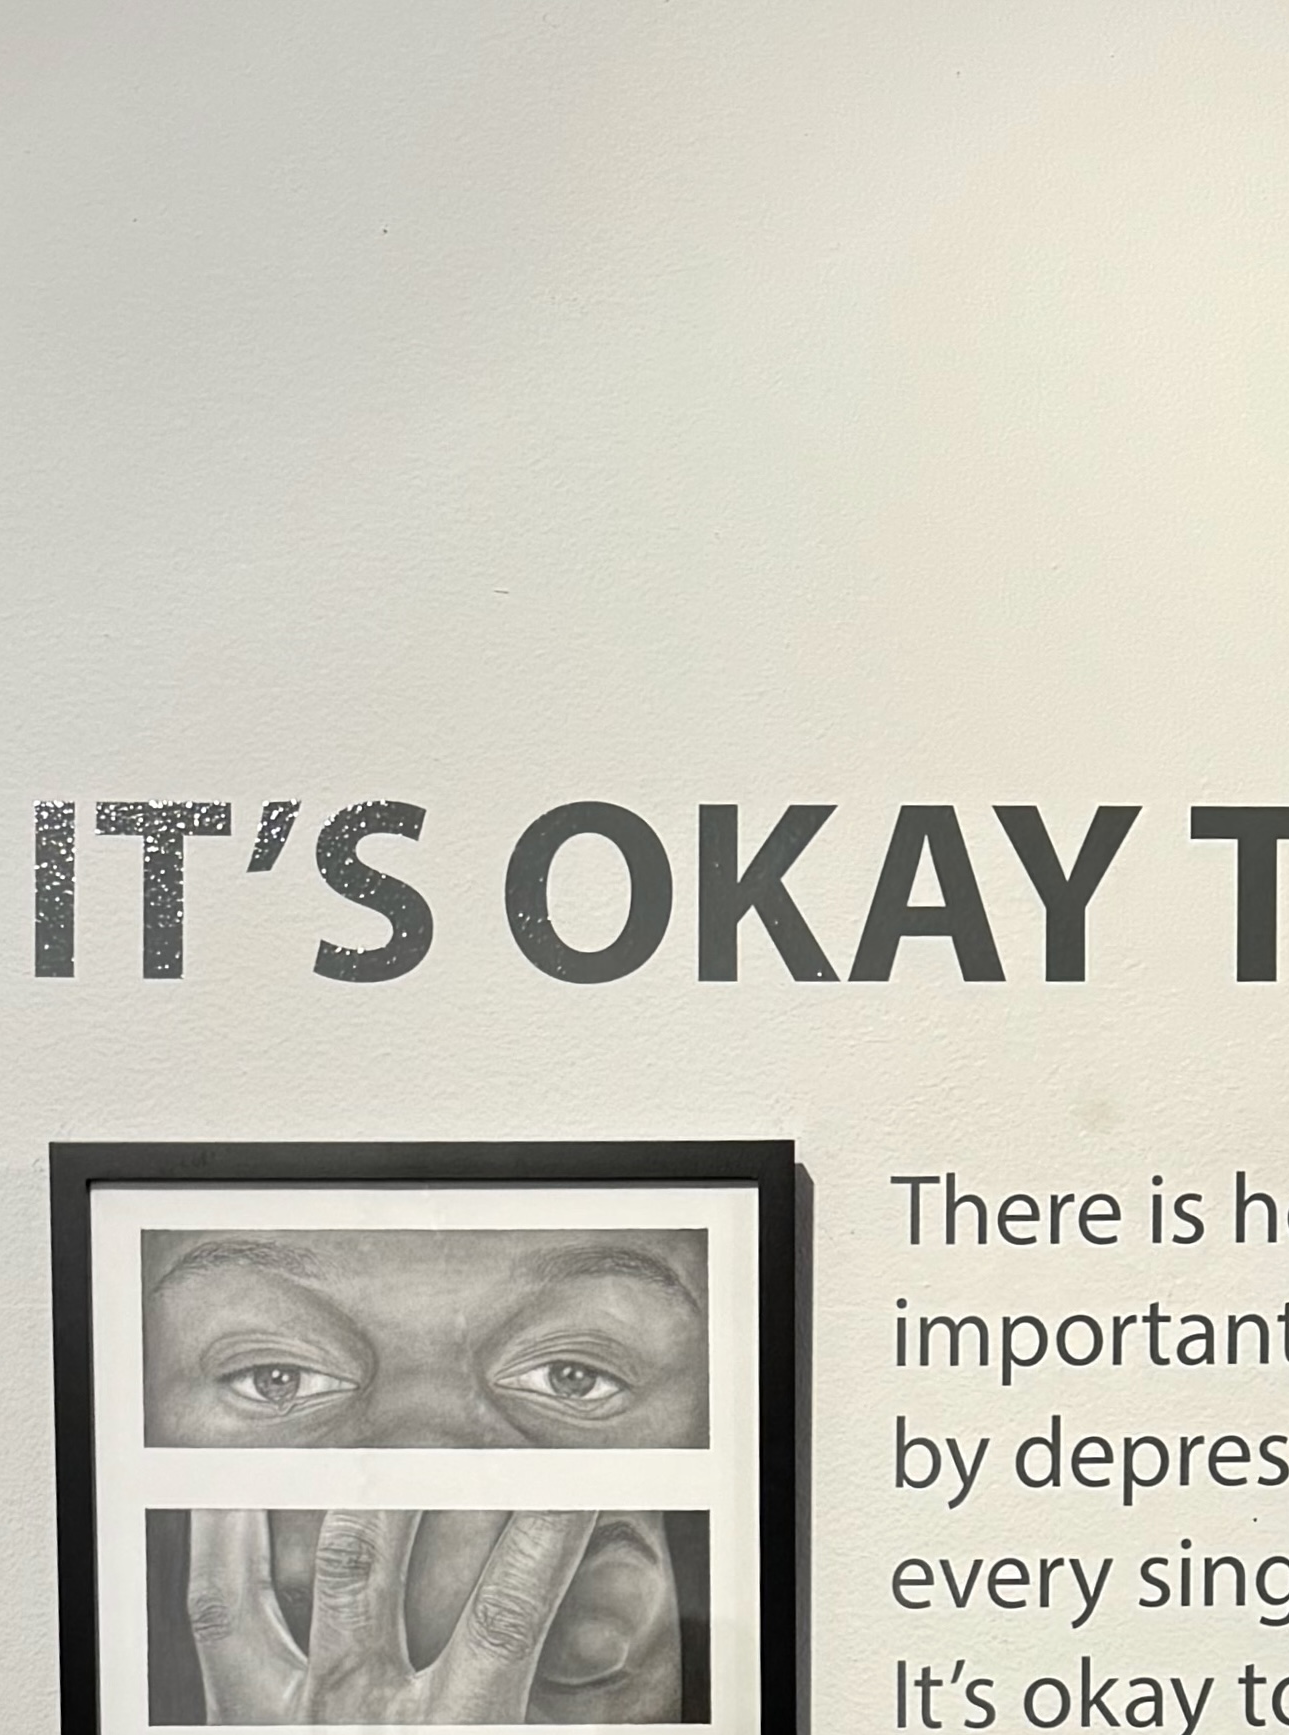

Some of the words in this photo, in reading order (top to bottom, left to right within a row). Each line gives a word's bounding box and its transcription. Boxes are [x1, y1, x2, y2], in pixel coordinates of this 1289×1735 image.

[32, 798, 435, 985] IT’S
[503, 799, 1145, 986] OKAY
[888, 1170, 1123, 1247] There
[1150, 1173, 1206, 1246] is
[893, 1414, 992, 1511] by
[890, 1556, 1115, 1631] every
[895, 1657, 998, 1731] It’s
